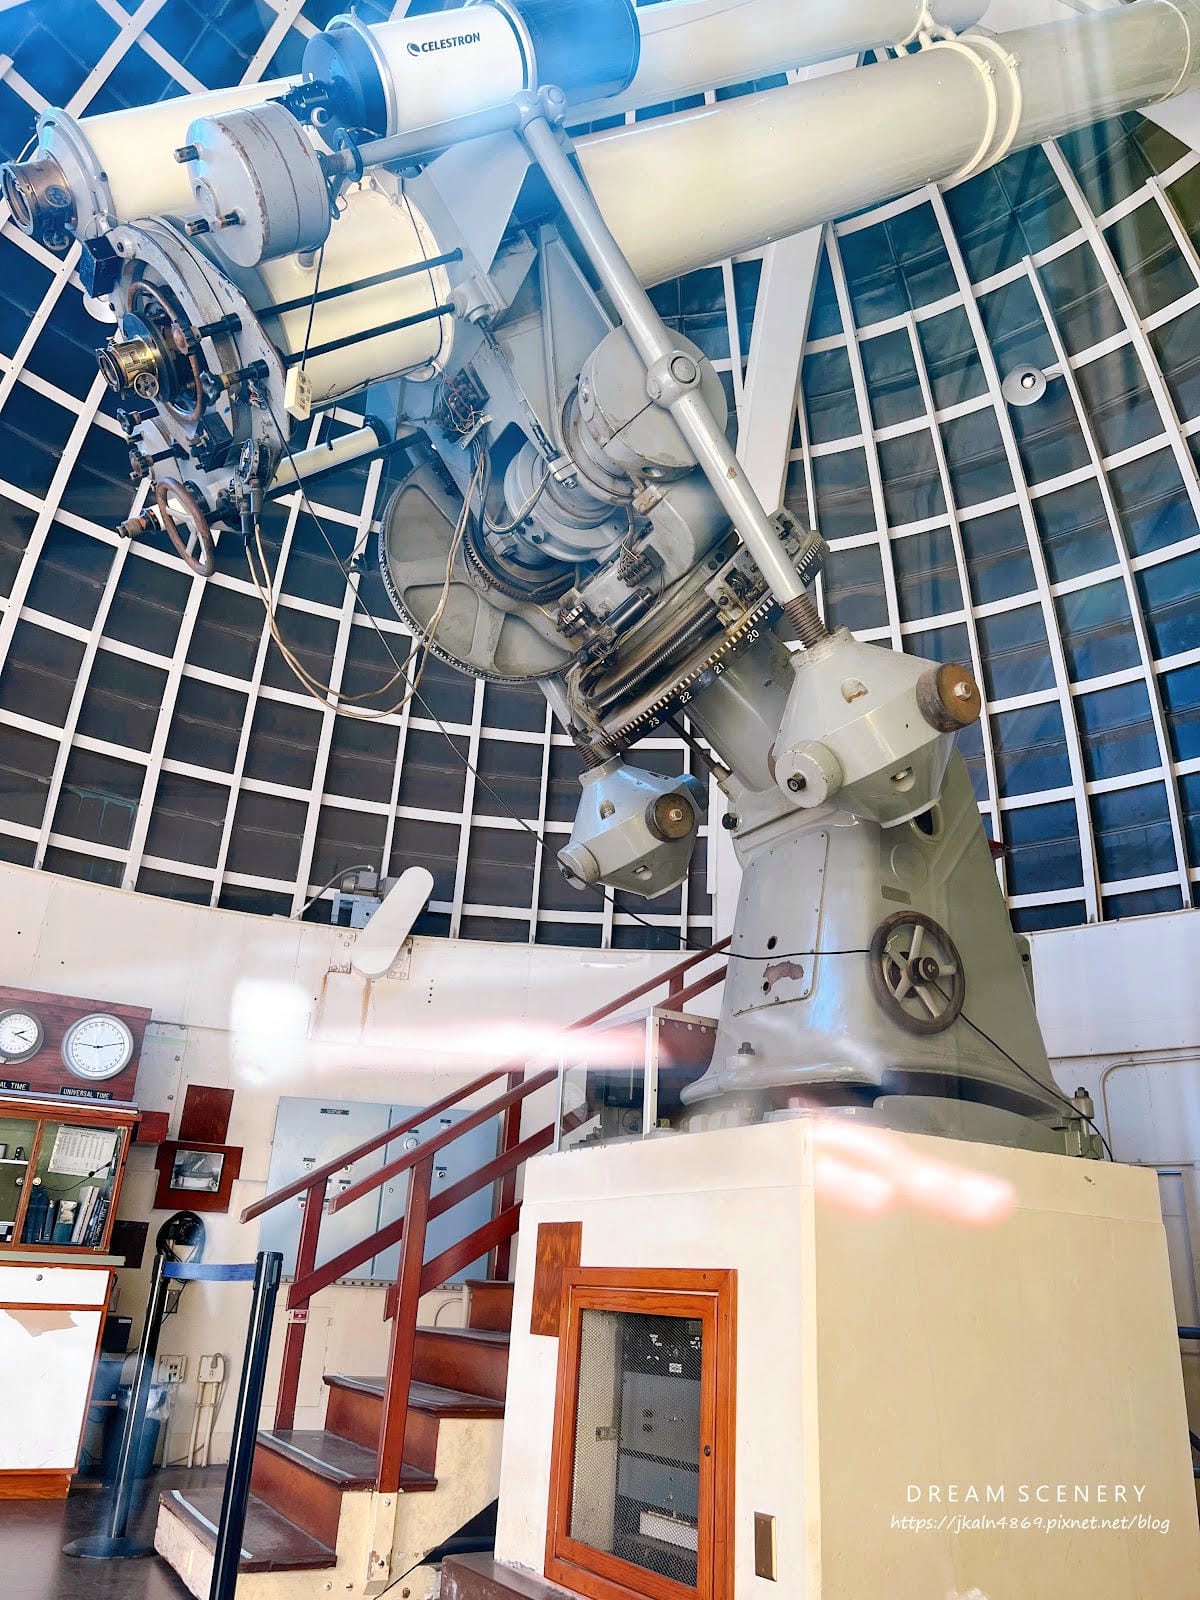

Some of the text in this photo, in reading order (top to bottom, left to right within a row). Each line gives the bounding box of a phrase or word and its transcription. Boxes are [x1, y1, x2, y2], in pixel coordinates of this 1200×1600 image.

[421, 32, 481, 52] CELESTRON
[802, 573, 811, 583] 18
[746, 629, 760, 643] 20
[713, 662, 725, 674] 21
[679, 691, 692, 704] 22
[648, 716, 660, 728] 23
[11, 1082, 27, 1091] TIME
[63, 1088, 110, 1100] UNIVERSAL TIME
